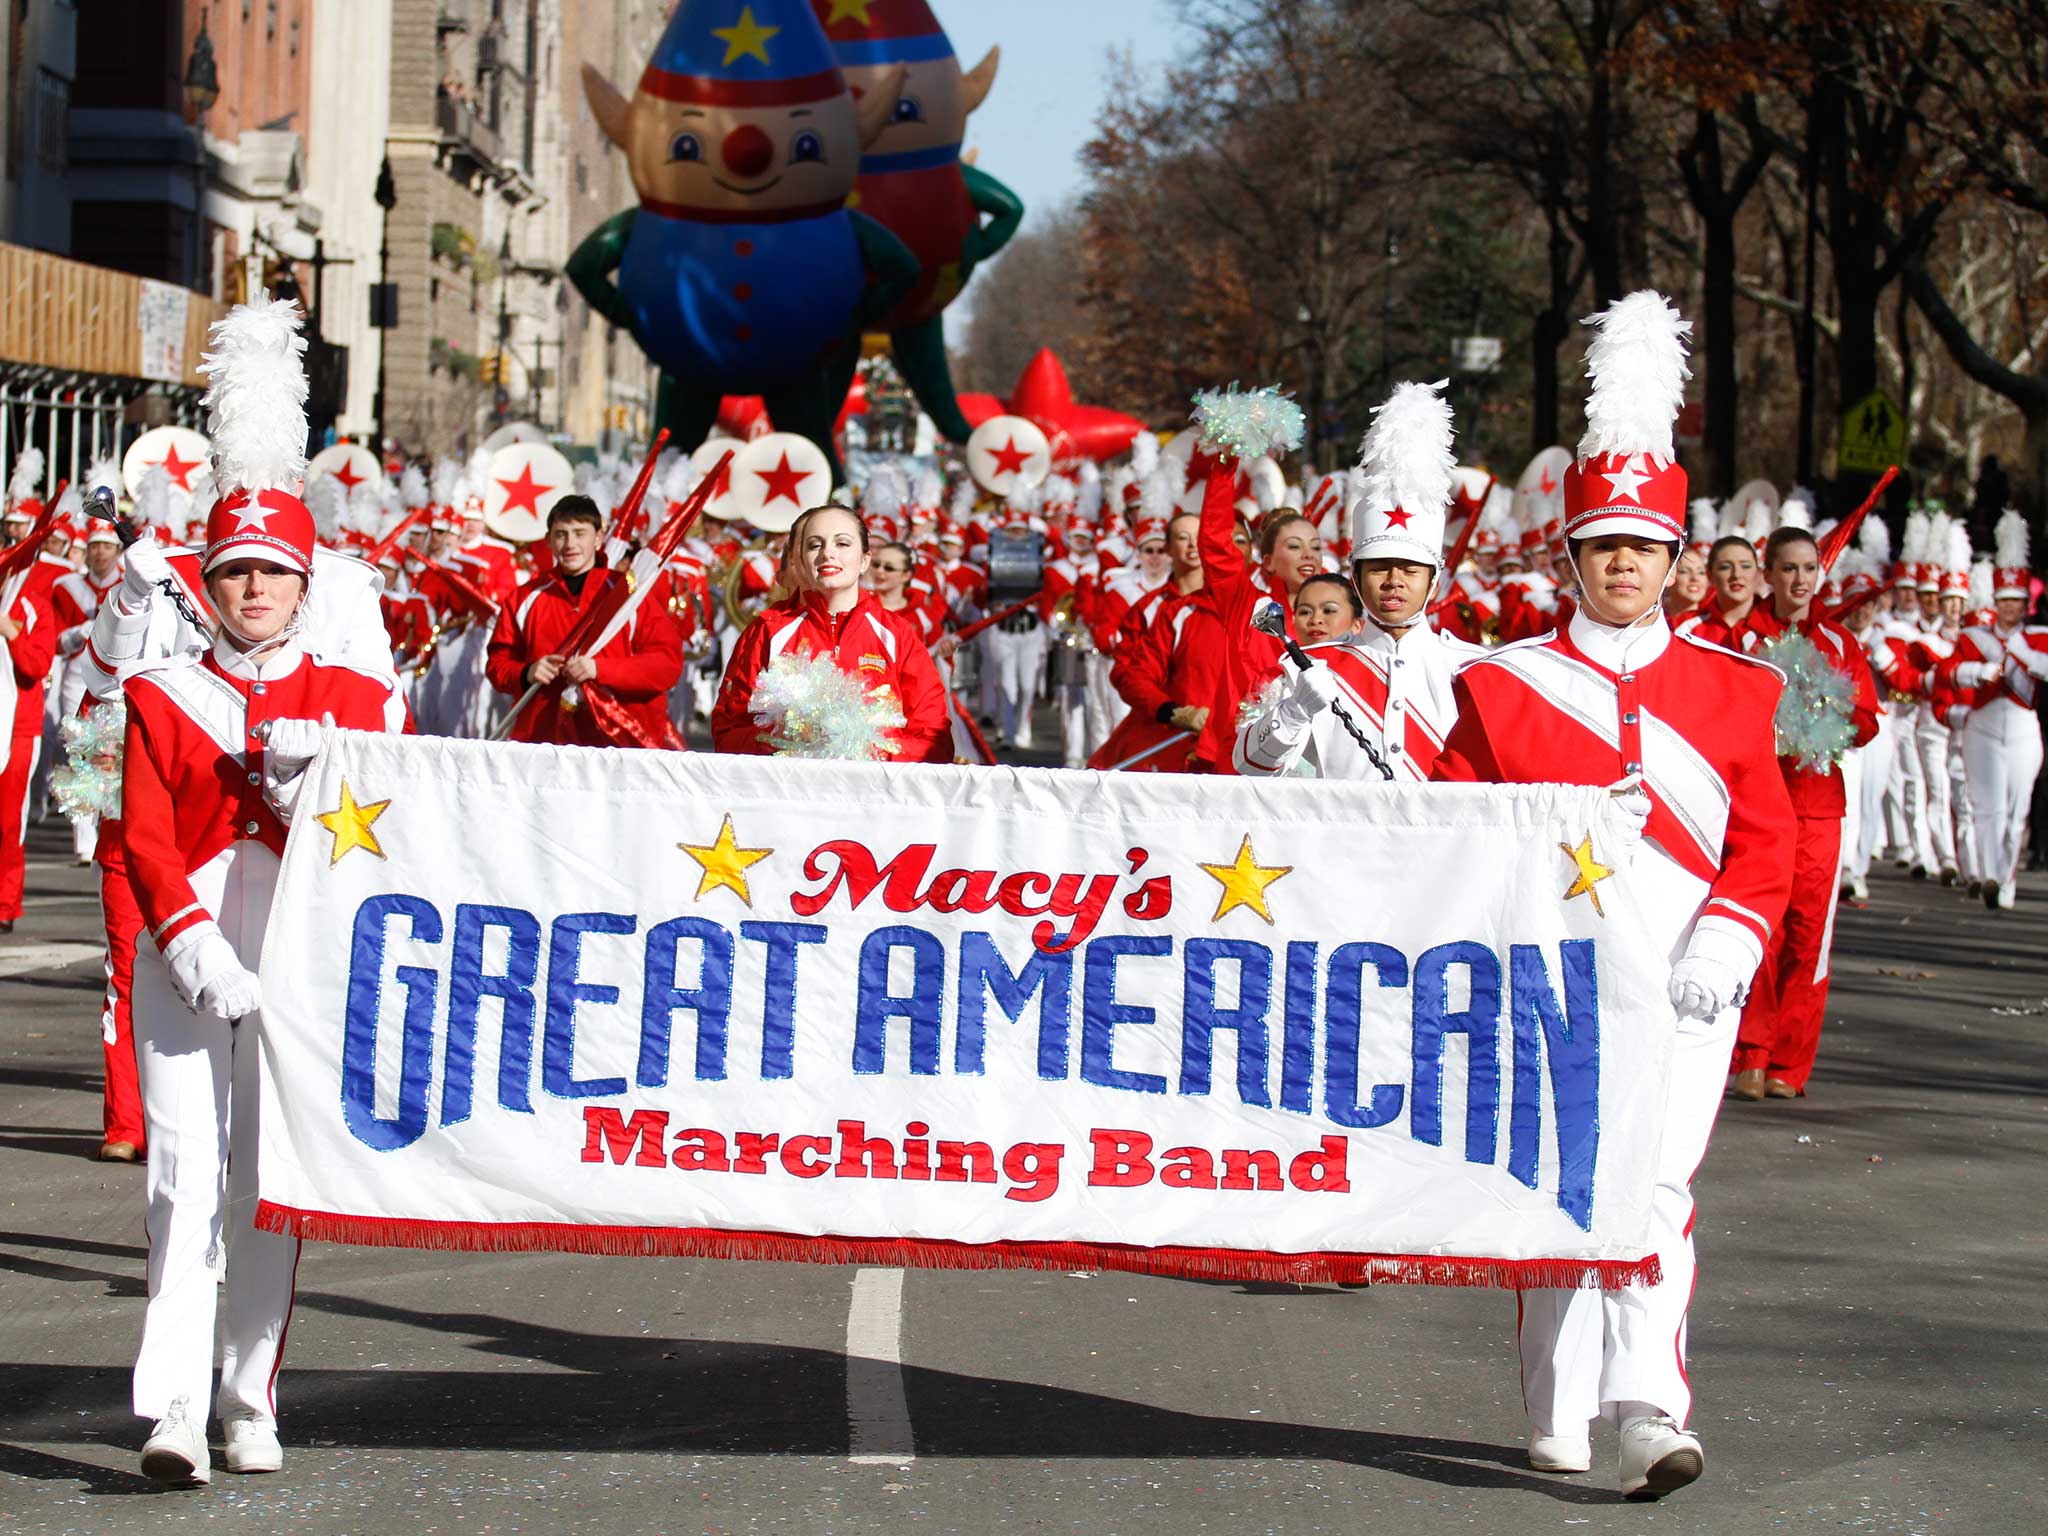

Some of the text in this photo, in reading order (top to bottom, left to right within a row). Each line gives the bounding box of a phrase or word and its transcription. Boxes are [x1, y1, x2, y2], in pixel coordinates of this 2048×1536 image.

[790, 839, 1172, 954] Macy's
[340, 893, 1601, 1234] GREAT AMERICAN
[581, 1106, 1351, 1202] Marching Band
